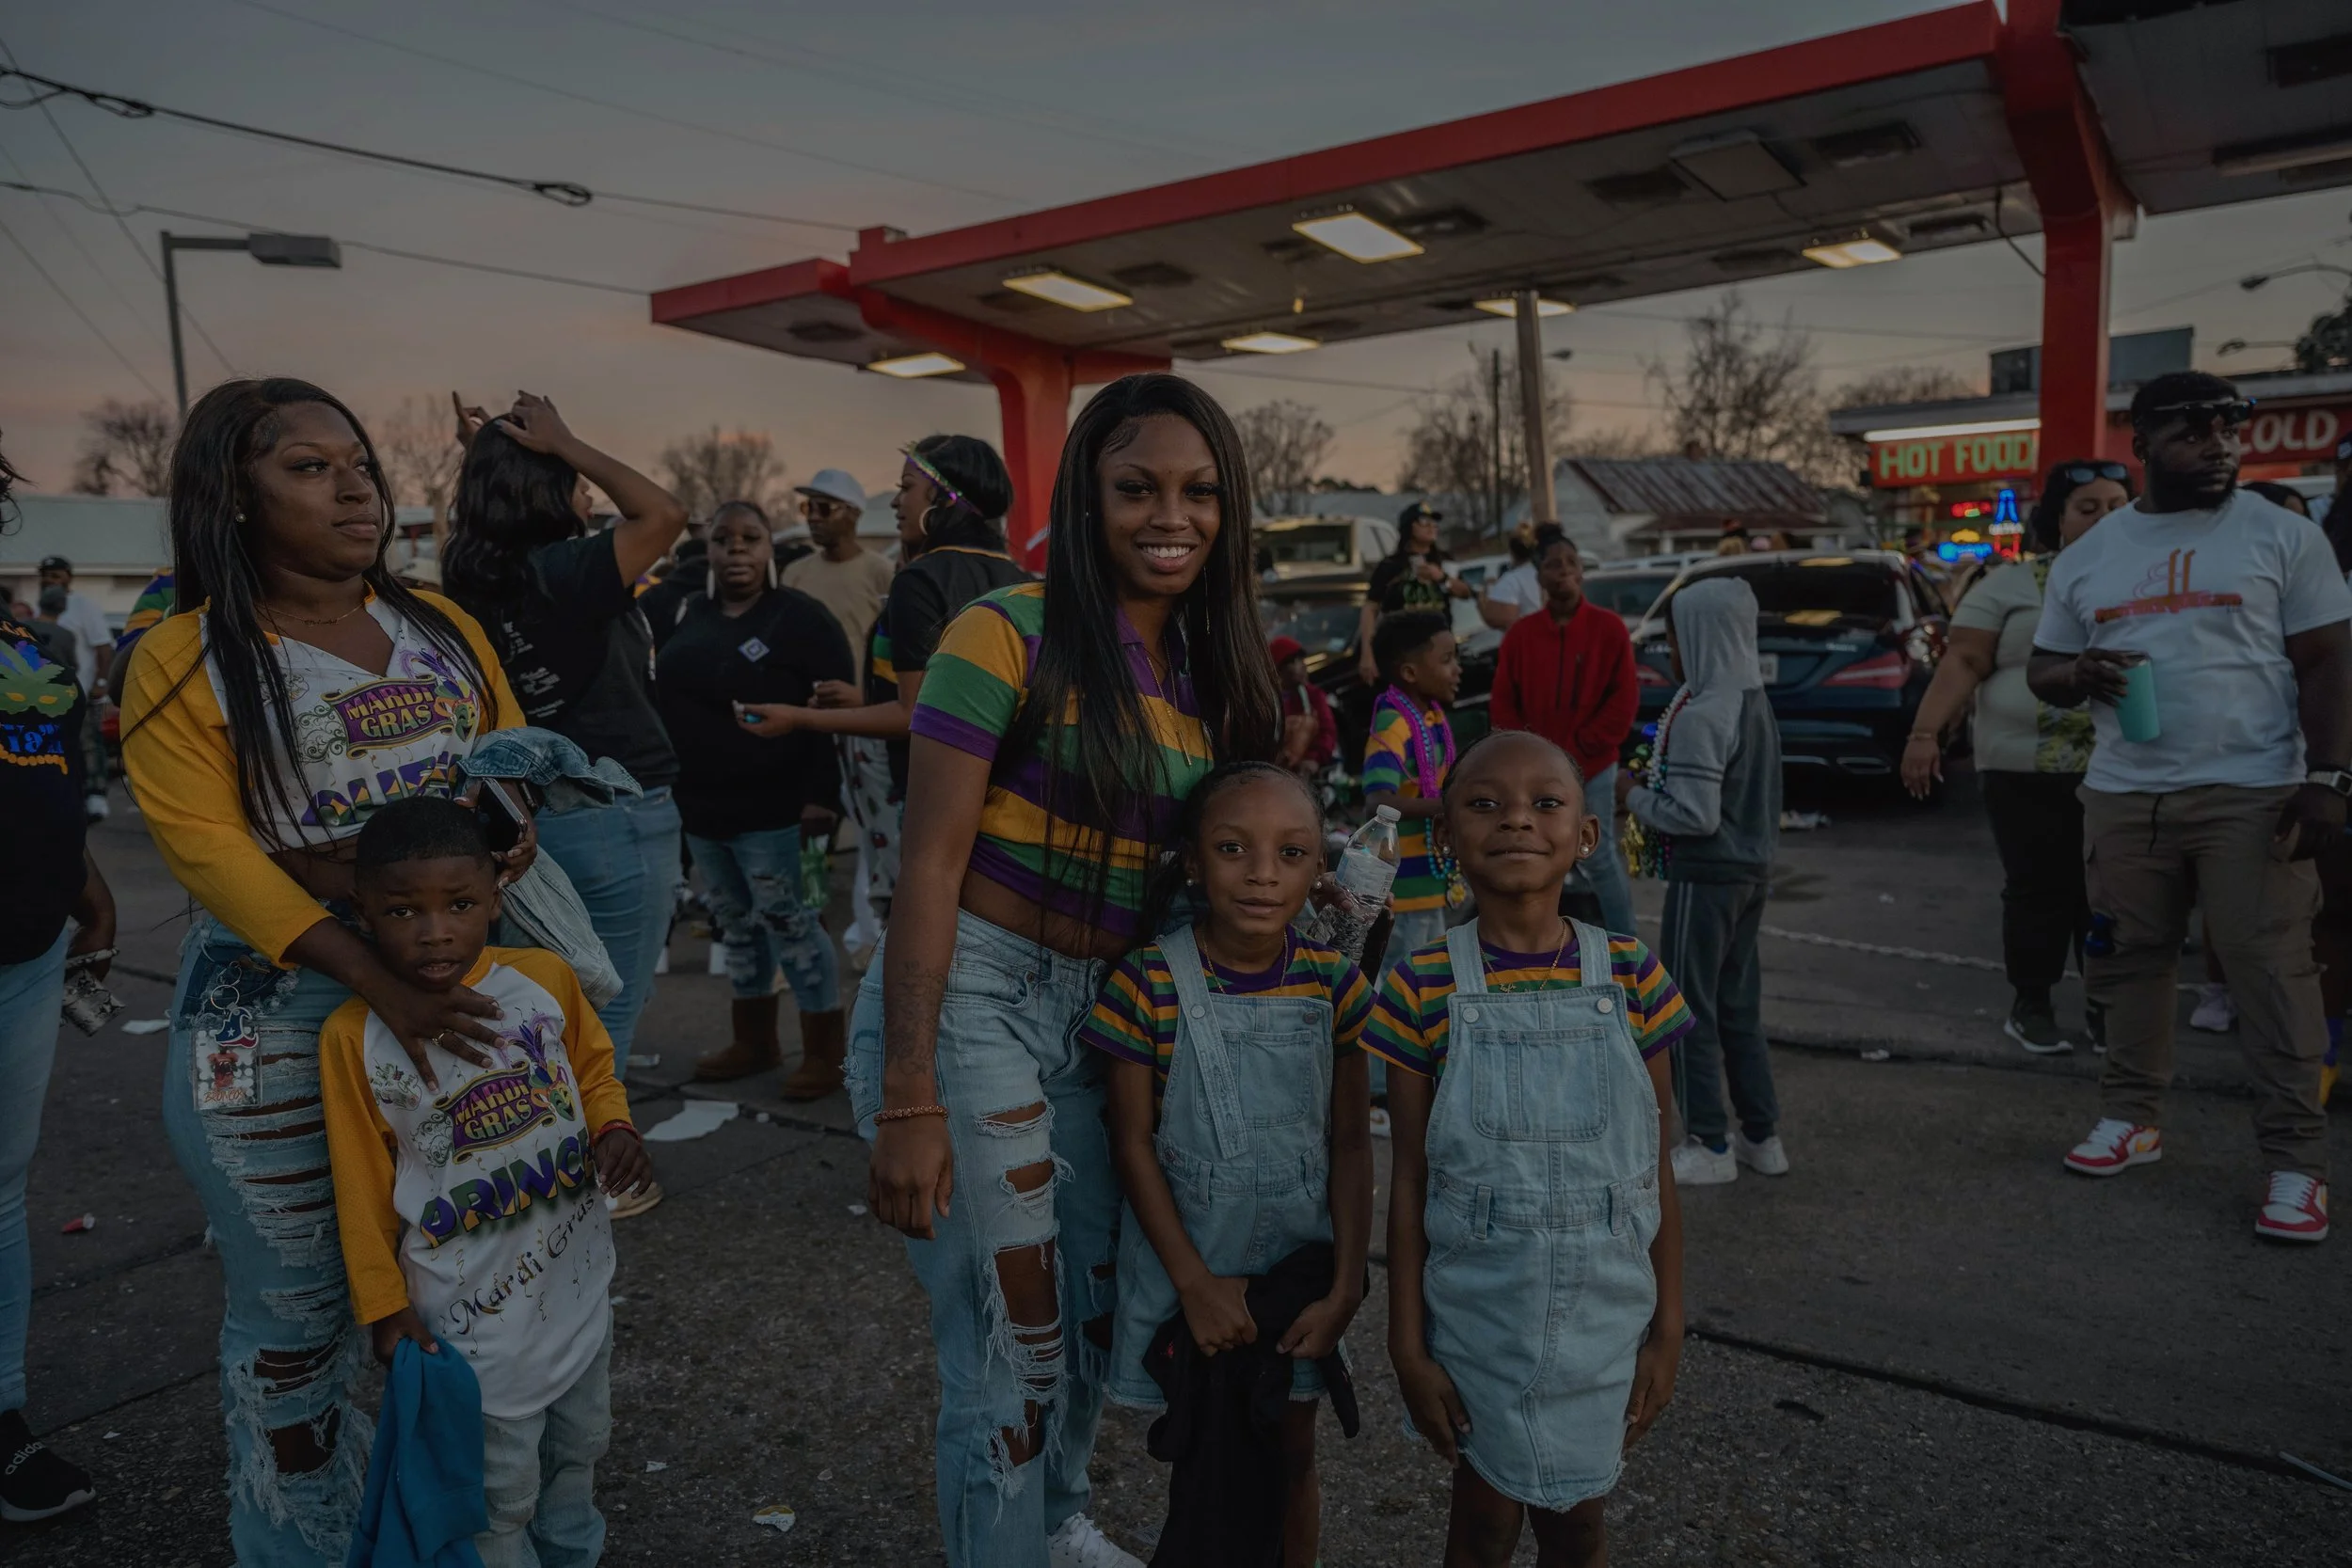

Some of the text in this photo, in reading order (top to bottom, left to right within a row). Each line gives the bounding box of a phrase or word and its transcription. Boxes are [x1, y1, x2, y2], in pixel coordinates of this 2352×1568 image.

[1880, 433, 2034, 479] HOT FOOD
[344, 685, 435, 721] MARDI
[360, 705, 433, 738] GRAS
[454, 1079, 530, 1126] MARDI
[464, 1098, 532, 1140] GRAS
[450, 1192, 595, 1335] Mardi Gras
[5, 1440, 47, 1476] adida
